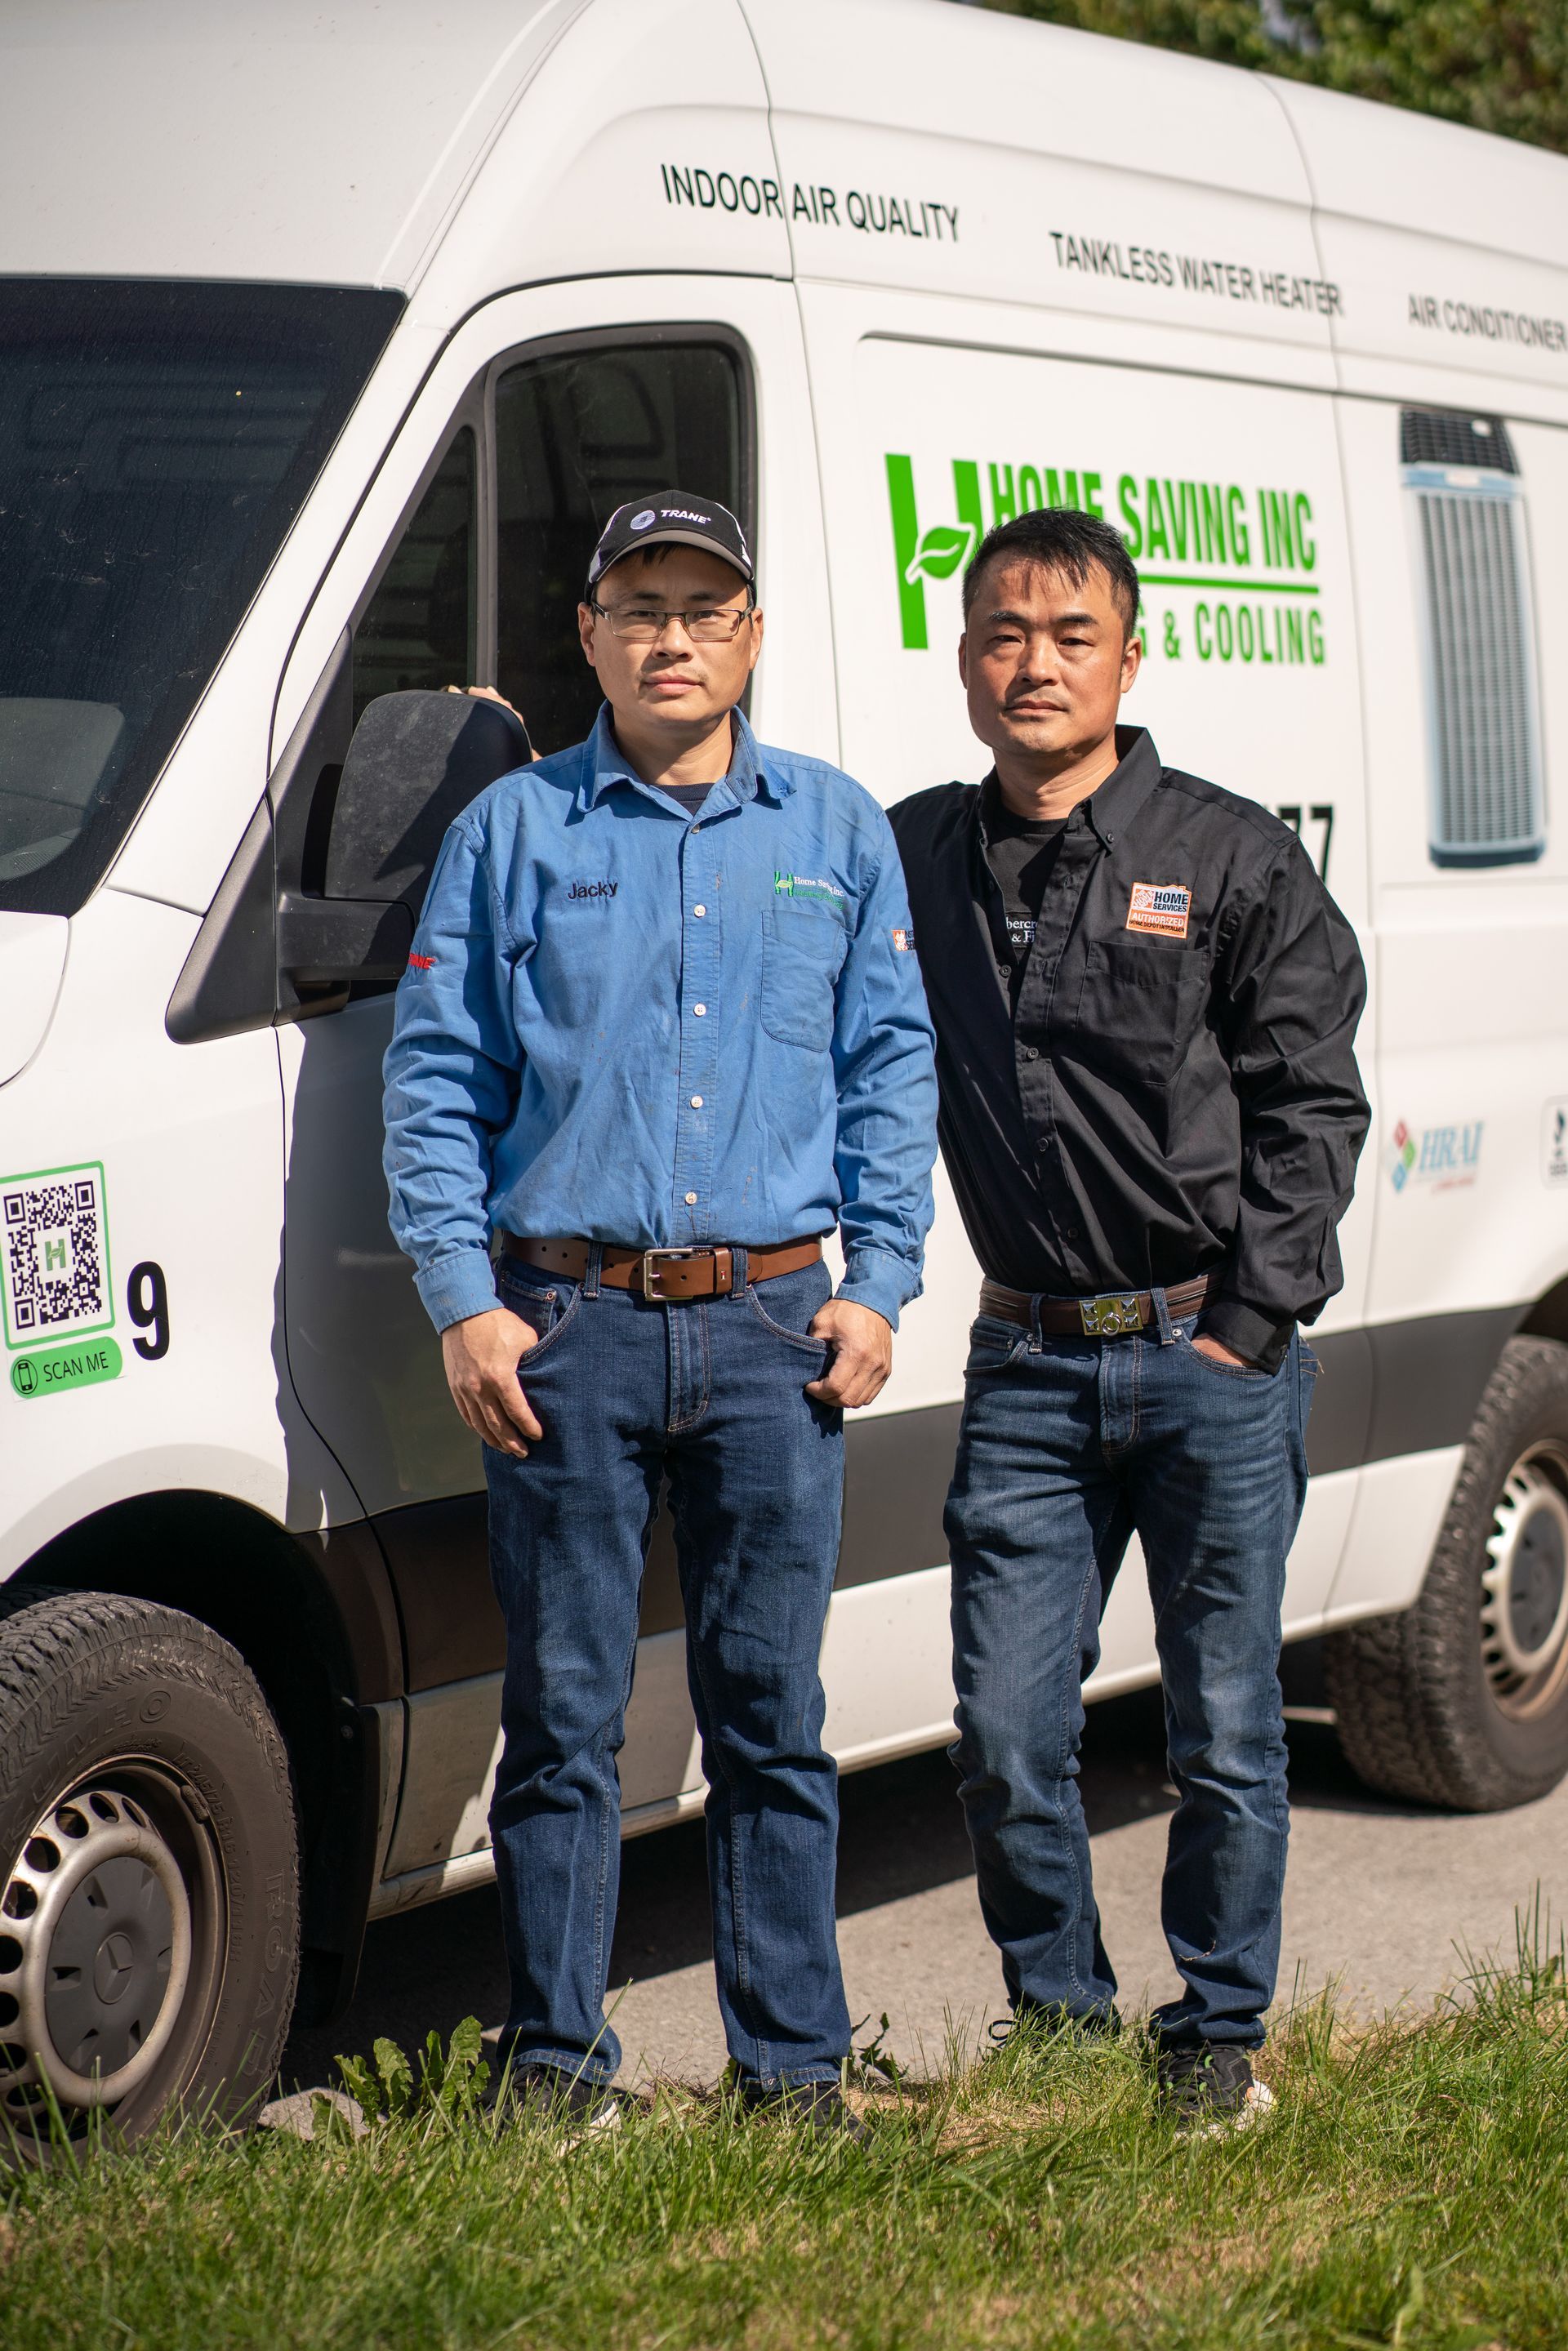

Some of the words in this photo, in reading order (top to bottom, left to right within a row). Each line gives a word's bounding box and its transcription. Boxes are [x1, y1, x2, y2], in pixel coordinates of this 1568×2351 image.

[661, 163, 783, 218] INDOOR
[792, 183, 840, 225] AIR
[847, 191, 959, 242] QUALITY
[1049, 231, 1175, 287] TANKLESS
[1176, 253, 1257, 301] WATER
[1258, 269, 1347, 316] HEATER
[1409, 293, 1440, 329] AIR
[1442, 299, 1568, 353] CONDITIONER
[660, 510, 708, 524] TRANE
[1116, 473, 1250, 567] SAVING
[1257, 488, 1317, 572] INC
[1163, 610, 1182, 660] &
[1194, 601, 1325, 665] COOLING
[568, 881, 619, 900] Jacky
[794, 876, 817, 886] Home
[1152, 902, 1187, 913] SERVICES
[1154, 891, 1189, 905] HOME
[1132, 912, 1184, 927] AUTHORIZED
[127, 1261, 170, 1361] 9
[43, 1356, 83, 1383] SCAN
[87, 1351, 109, 1373] ME
